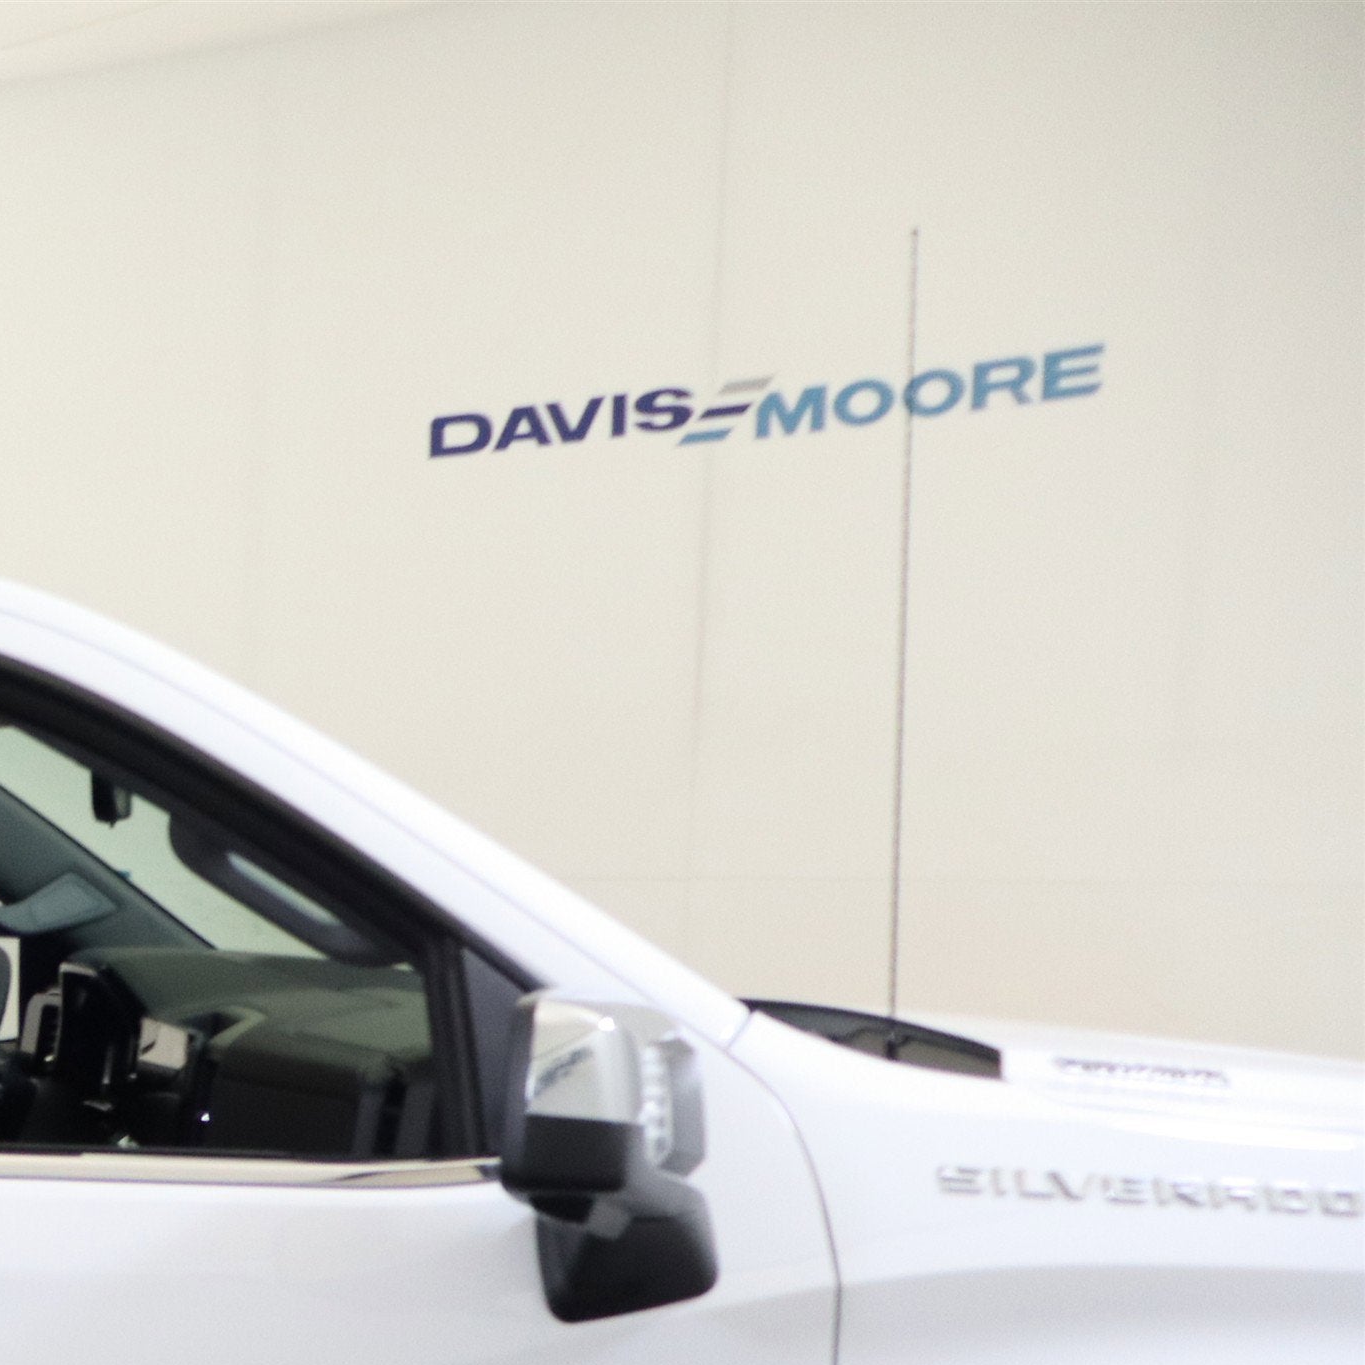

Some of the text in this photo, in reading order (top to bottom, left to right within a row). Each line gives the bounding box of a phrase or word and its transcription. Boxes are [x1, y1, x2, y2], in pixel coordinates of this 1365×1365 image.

[428, 343, 1106, 459] DAVIS MOORE
[936, 1165, 1363, 1218] SILVERADO
